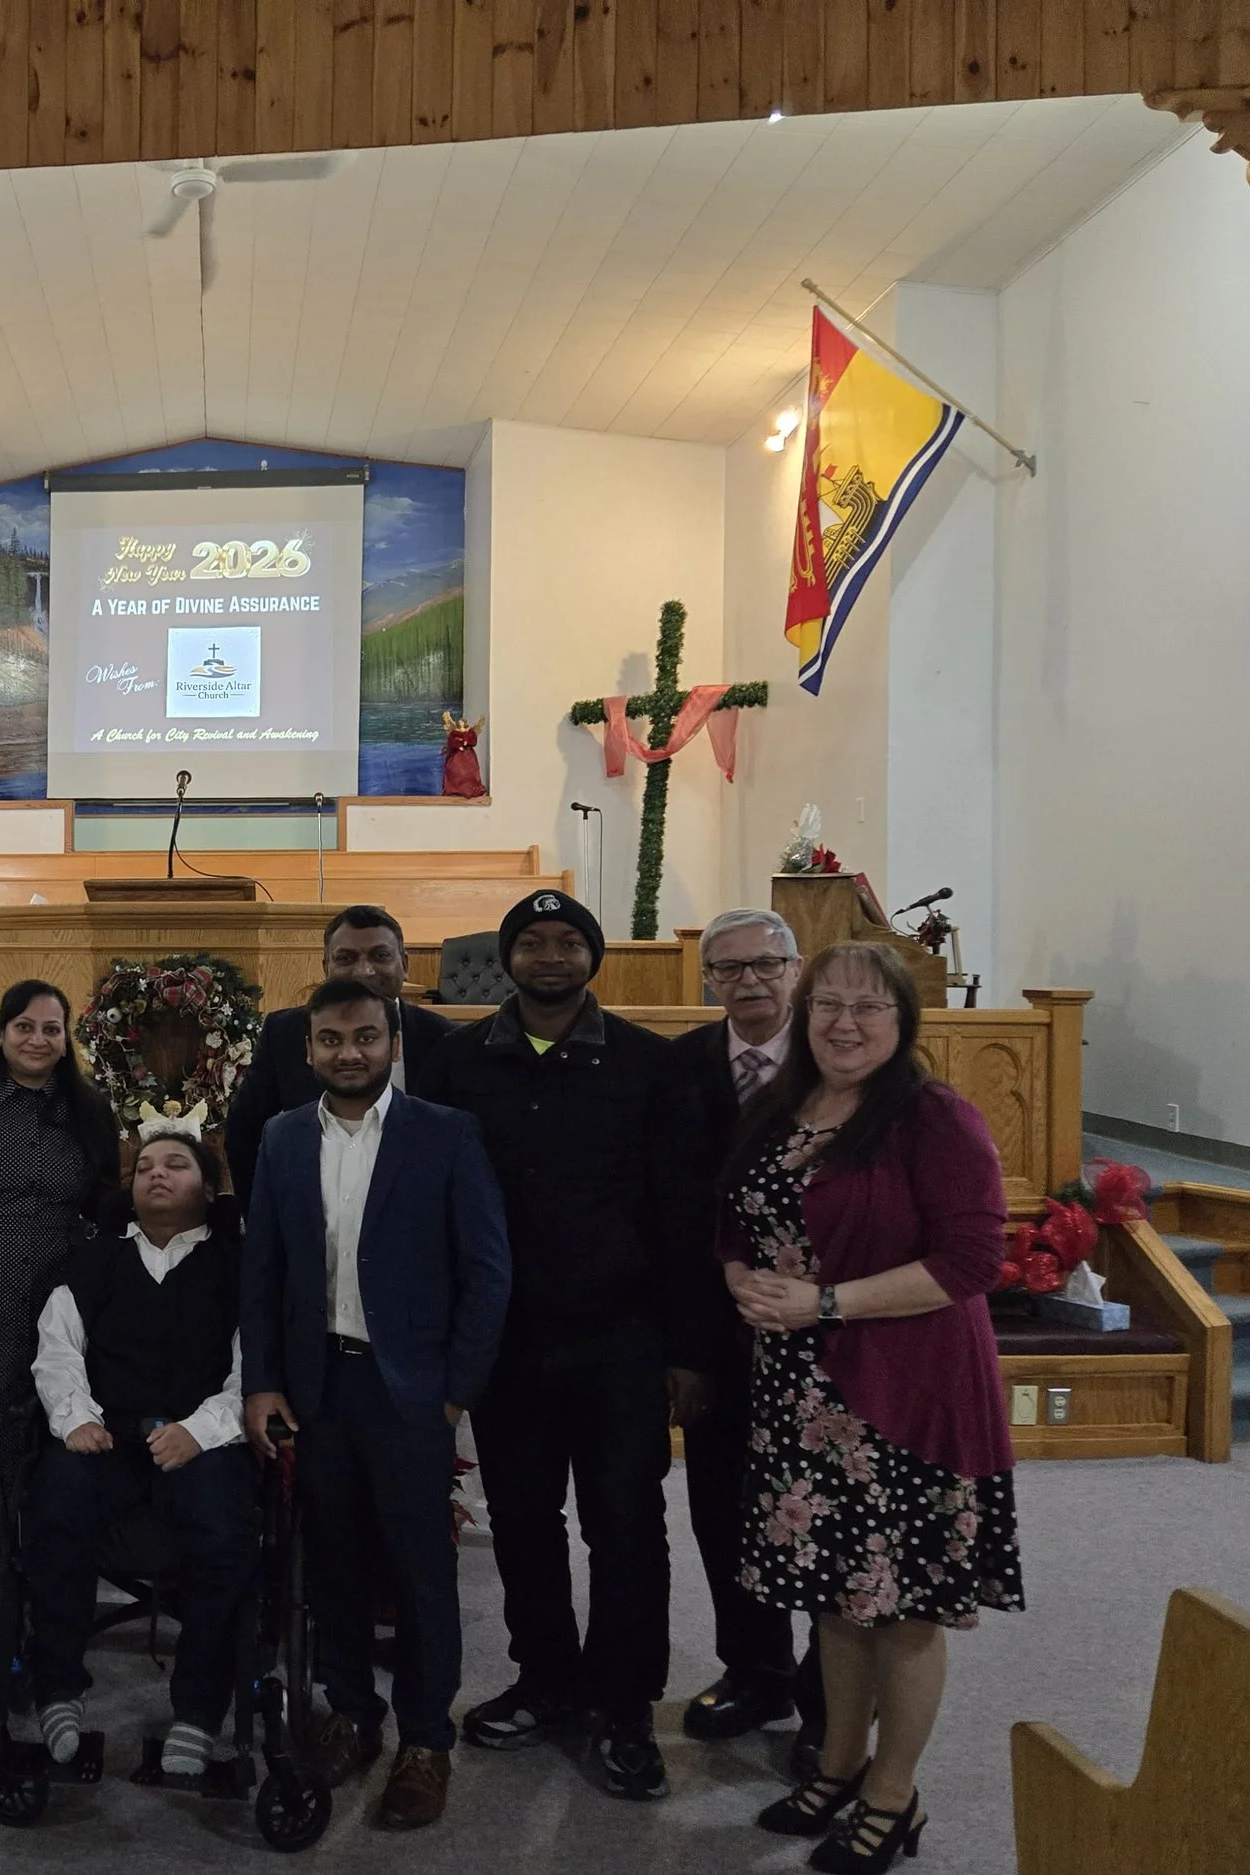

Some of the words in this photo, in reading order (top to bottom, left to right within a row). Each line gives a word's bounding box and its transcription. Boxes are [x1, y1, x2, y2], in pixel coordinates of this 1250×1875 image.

[114, 536, 177, 563] Happy
[189, 538, 311, 579] 2026
[104, 566, 142, 585] New
[145, 565, 187, 587] Year
[91, 599, 103, 616] A
[108, 598, 147, 616] YEAR
[175, 597, 224, 615] DIVINE
[229, 595, 320, 613] ASSURANCE
[85, 661, 139, 684] Wishes
[176, 681, 224, 691] Riverside
[225, 680, 252, 691] Altar
[197, 690, 229, 700] Church
[90, 728, 105, 742] A
[105, 728, 145, 743] Church
[145, 728, 162, 744] for
[165, 727, 190, 743] City
[192, 727, 235, 741] Revival
[236, 728, 258, 740] and
[259, 727, 320, 742] Awakening
